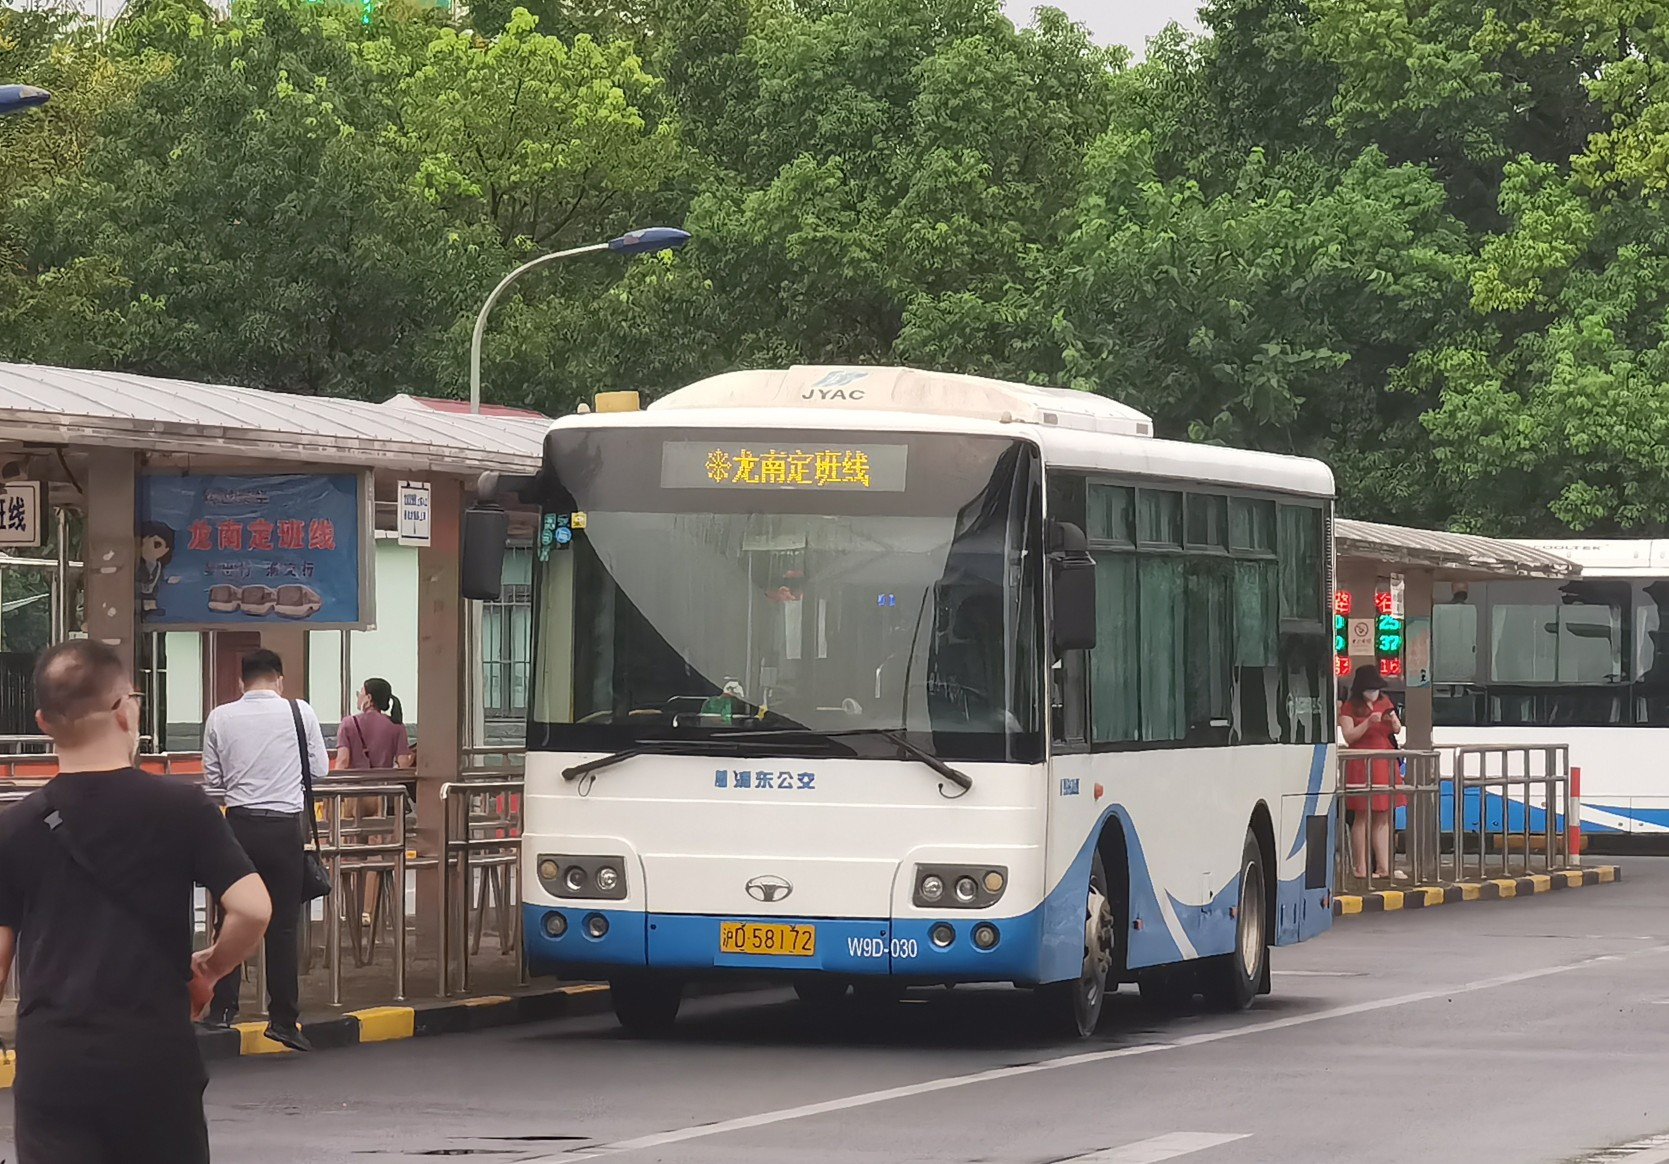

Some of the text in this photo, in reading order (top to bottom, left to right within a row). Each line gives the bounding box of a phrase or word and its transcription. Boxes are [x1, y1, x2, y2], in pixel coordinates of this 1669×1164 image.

[802, 389, 866, 400] JYAC
[732, 449, 870, 487] 龙南定班线
[187, 518, 336, 550] 龙南定班线
[847, 937, 918, 958] W9D-030
